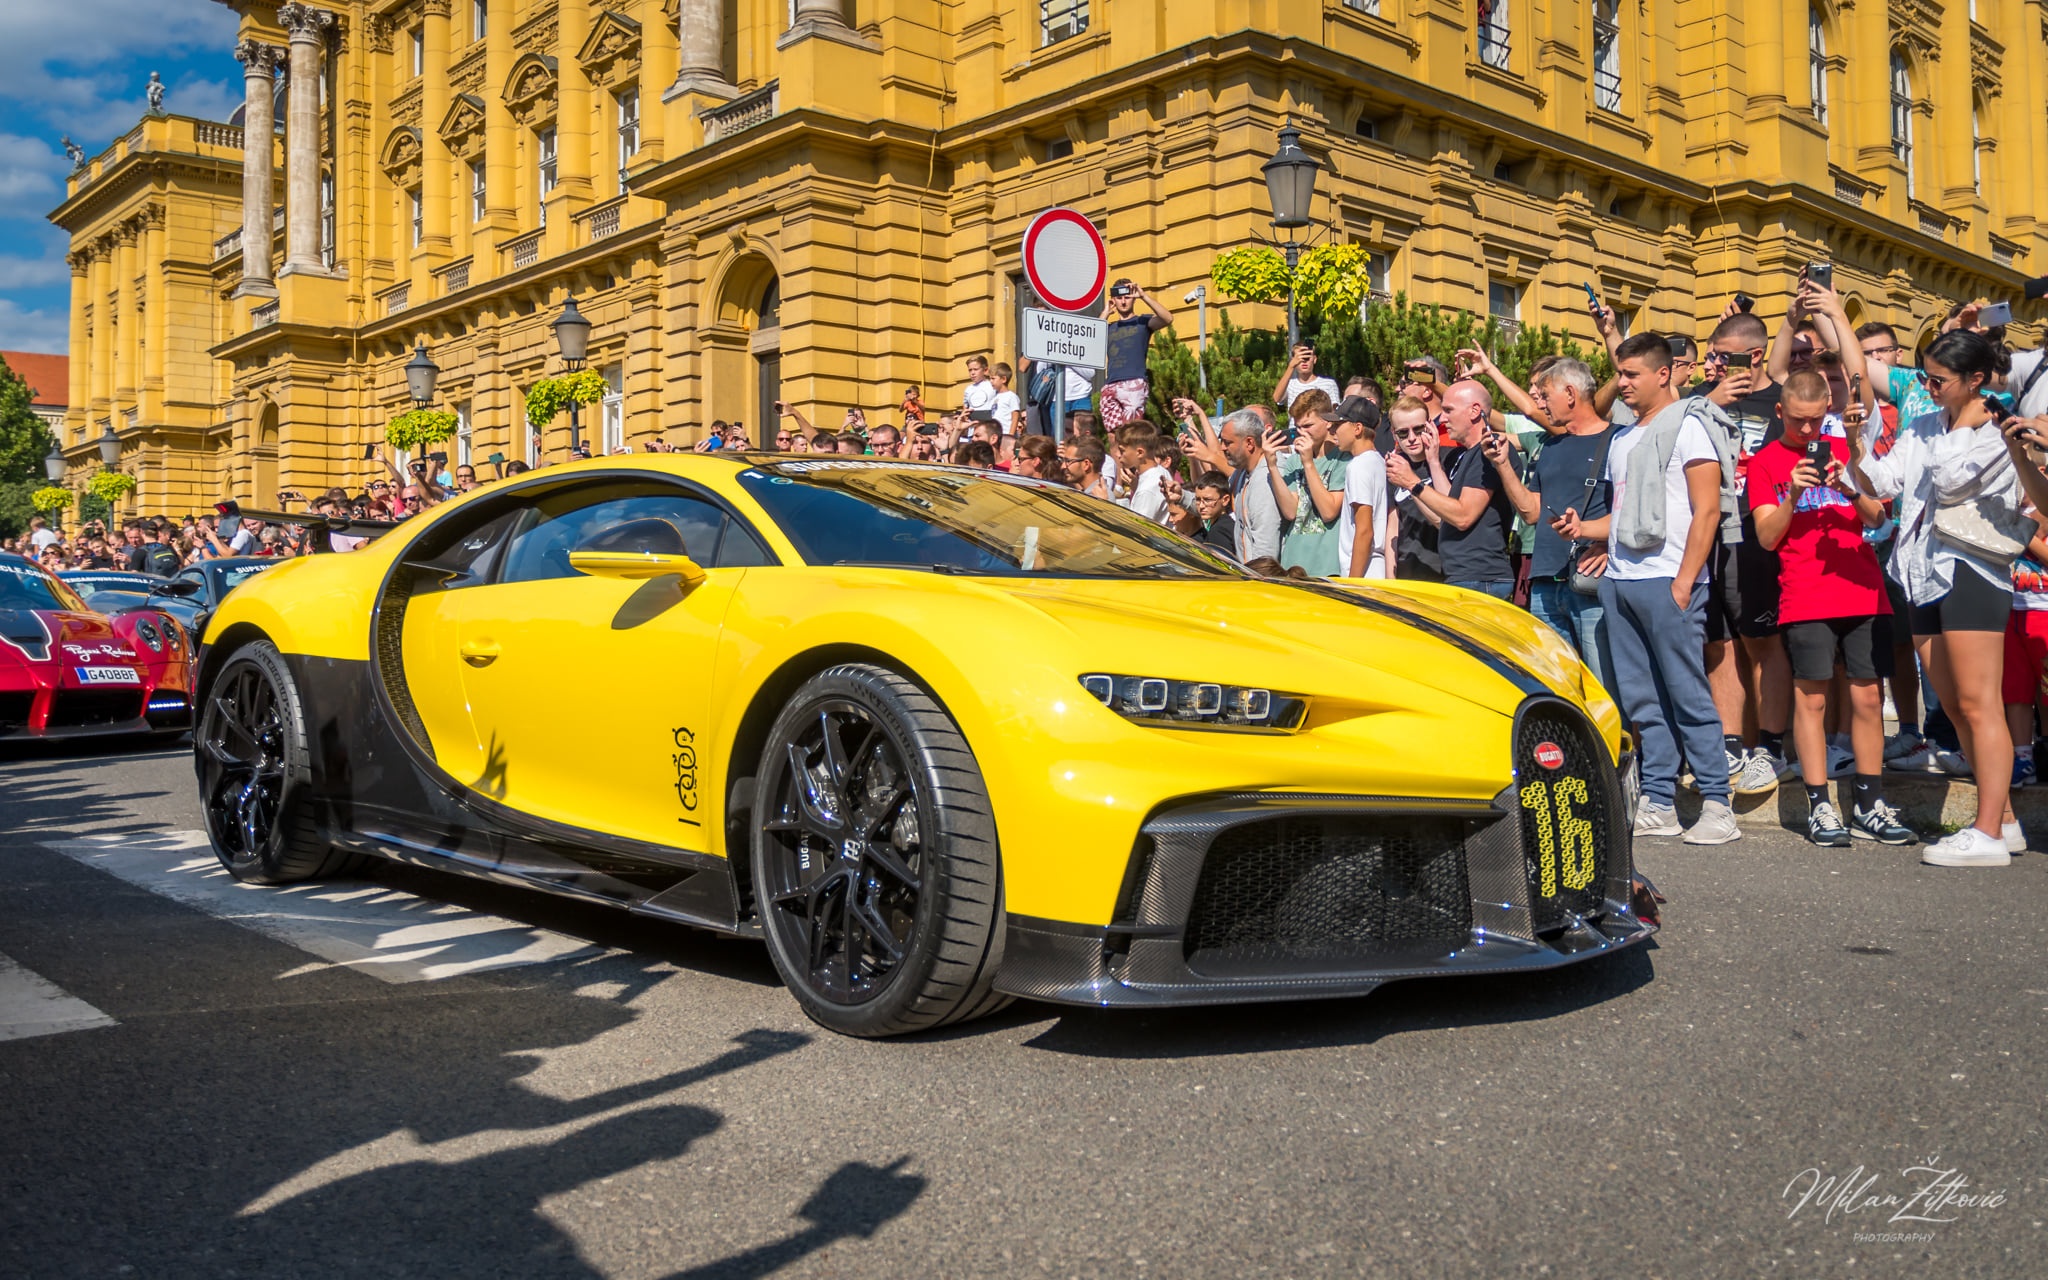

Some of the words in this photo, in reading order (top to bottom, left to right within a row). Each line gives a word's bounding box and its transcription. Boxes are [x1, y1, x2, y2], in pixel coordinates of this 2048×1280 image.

[1037, 314, 1096, 338] Vatrogasni
[1047, 339, 1085, 361] pristup
[1520, 775, 1595, 898] 16
